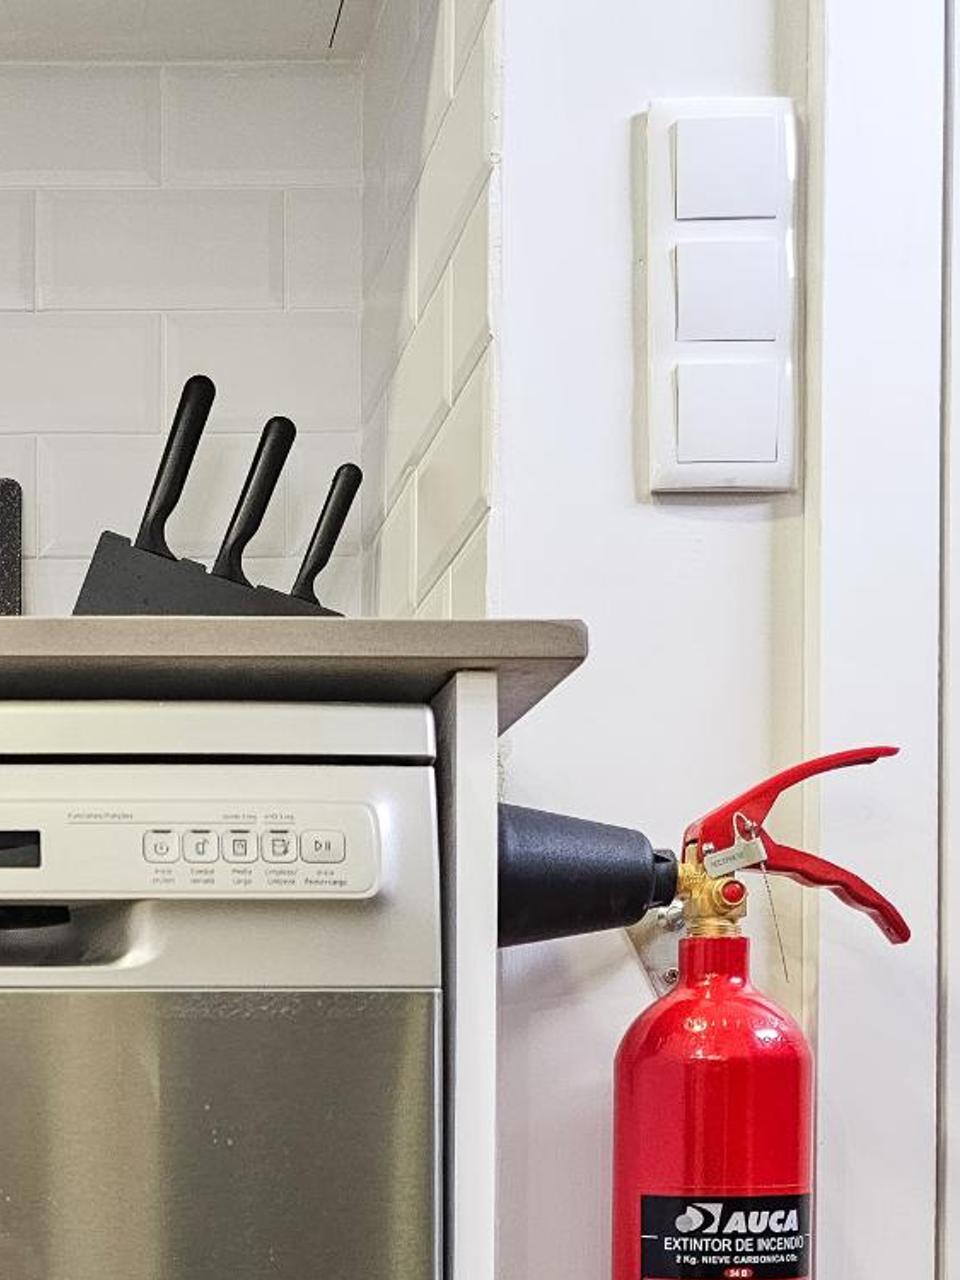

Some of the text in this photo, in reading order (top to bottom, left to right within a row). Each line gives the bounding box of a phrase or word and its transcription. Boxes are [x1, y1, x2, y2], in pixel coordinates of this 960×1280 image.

[723, 1210, 799, 1234] AUCA
[664, 1235, 804, 1252] EXTINTOR DE INCENDIO
[701, 1255, 731, 1264] NIEVE
